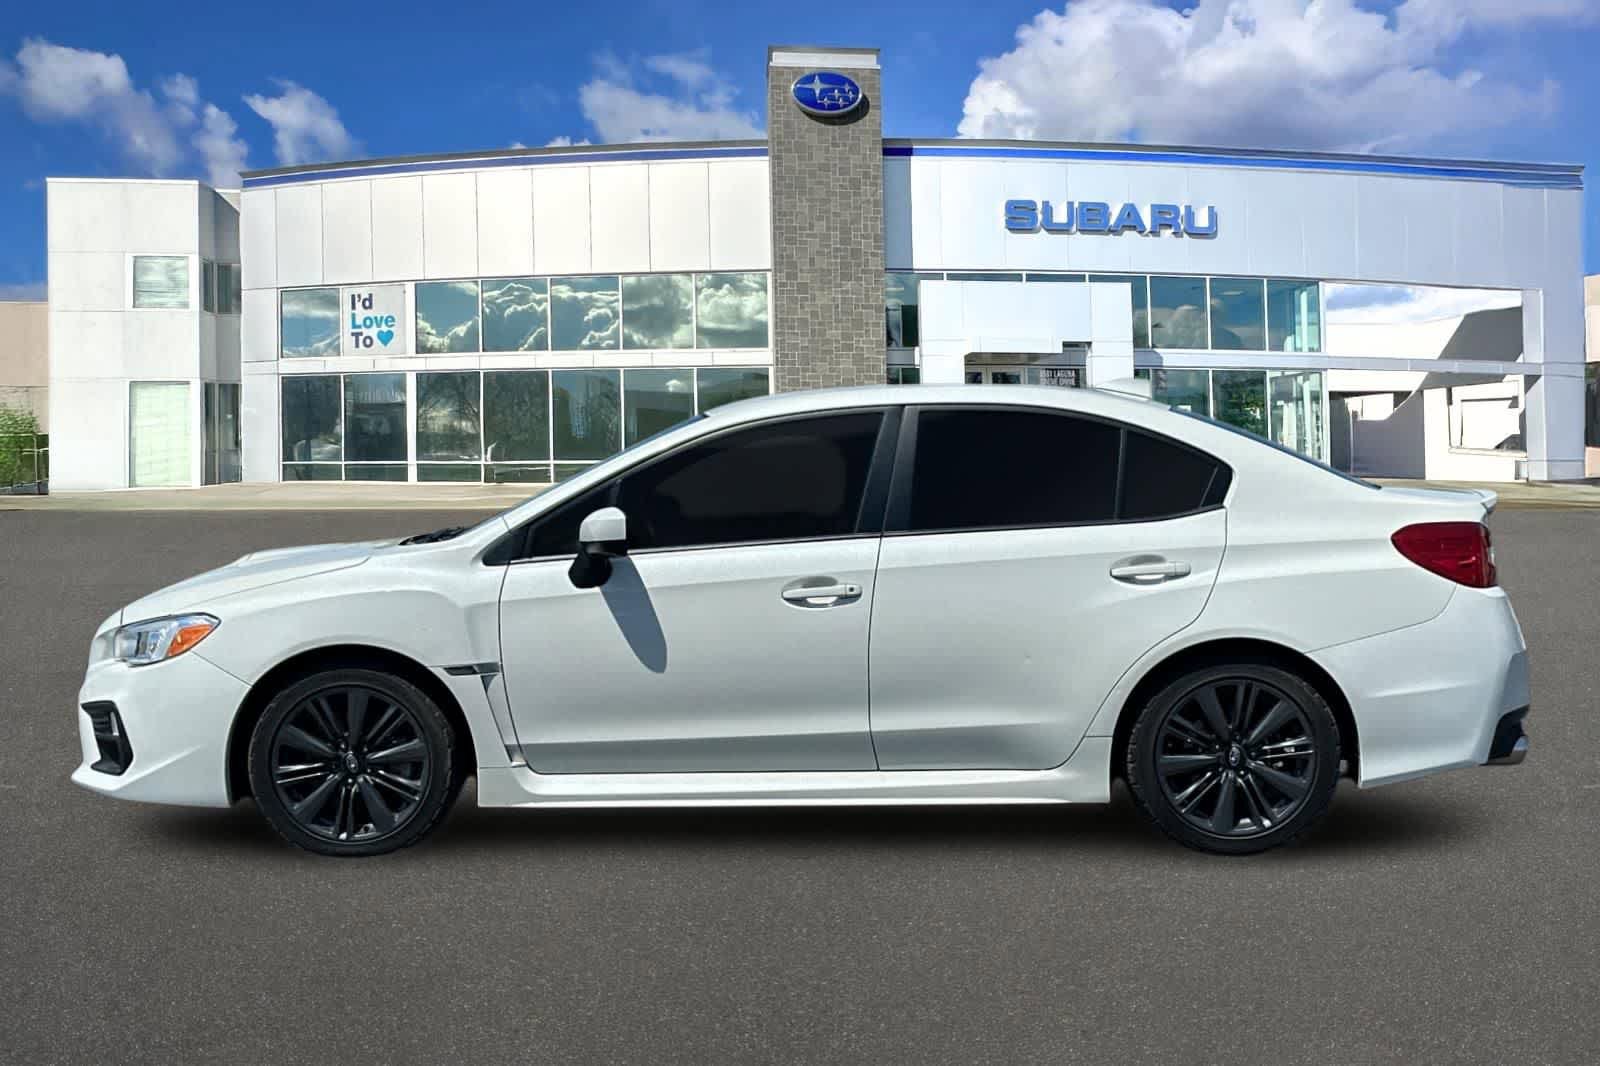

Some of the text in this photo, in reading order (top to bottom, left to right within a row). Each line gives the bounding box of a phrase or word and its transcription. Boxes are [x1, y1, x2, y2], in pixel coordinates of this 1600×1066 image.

[1005, 199, 1217, 238] SUBARU
[351, 293, 373, 310] I'd
[351, 312, 396, 329] Love
[351, 331, 374, 348] To
